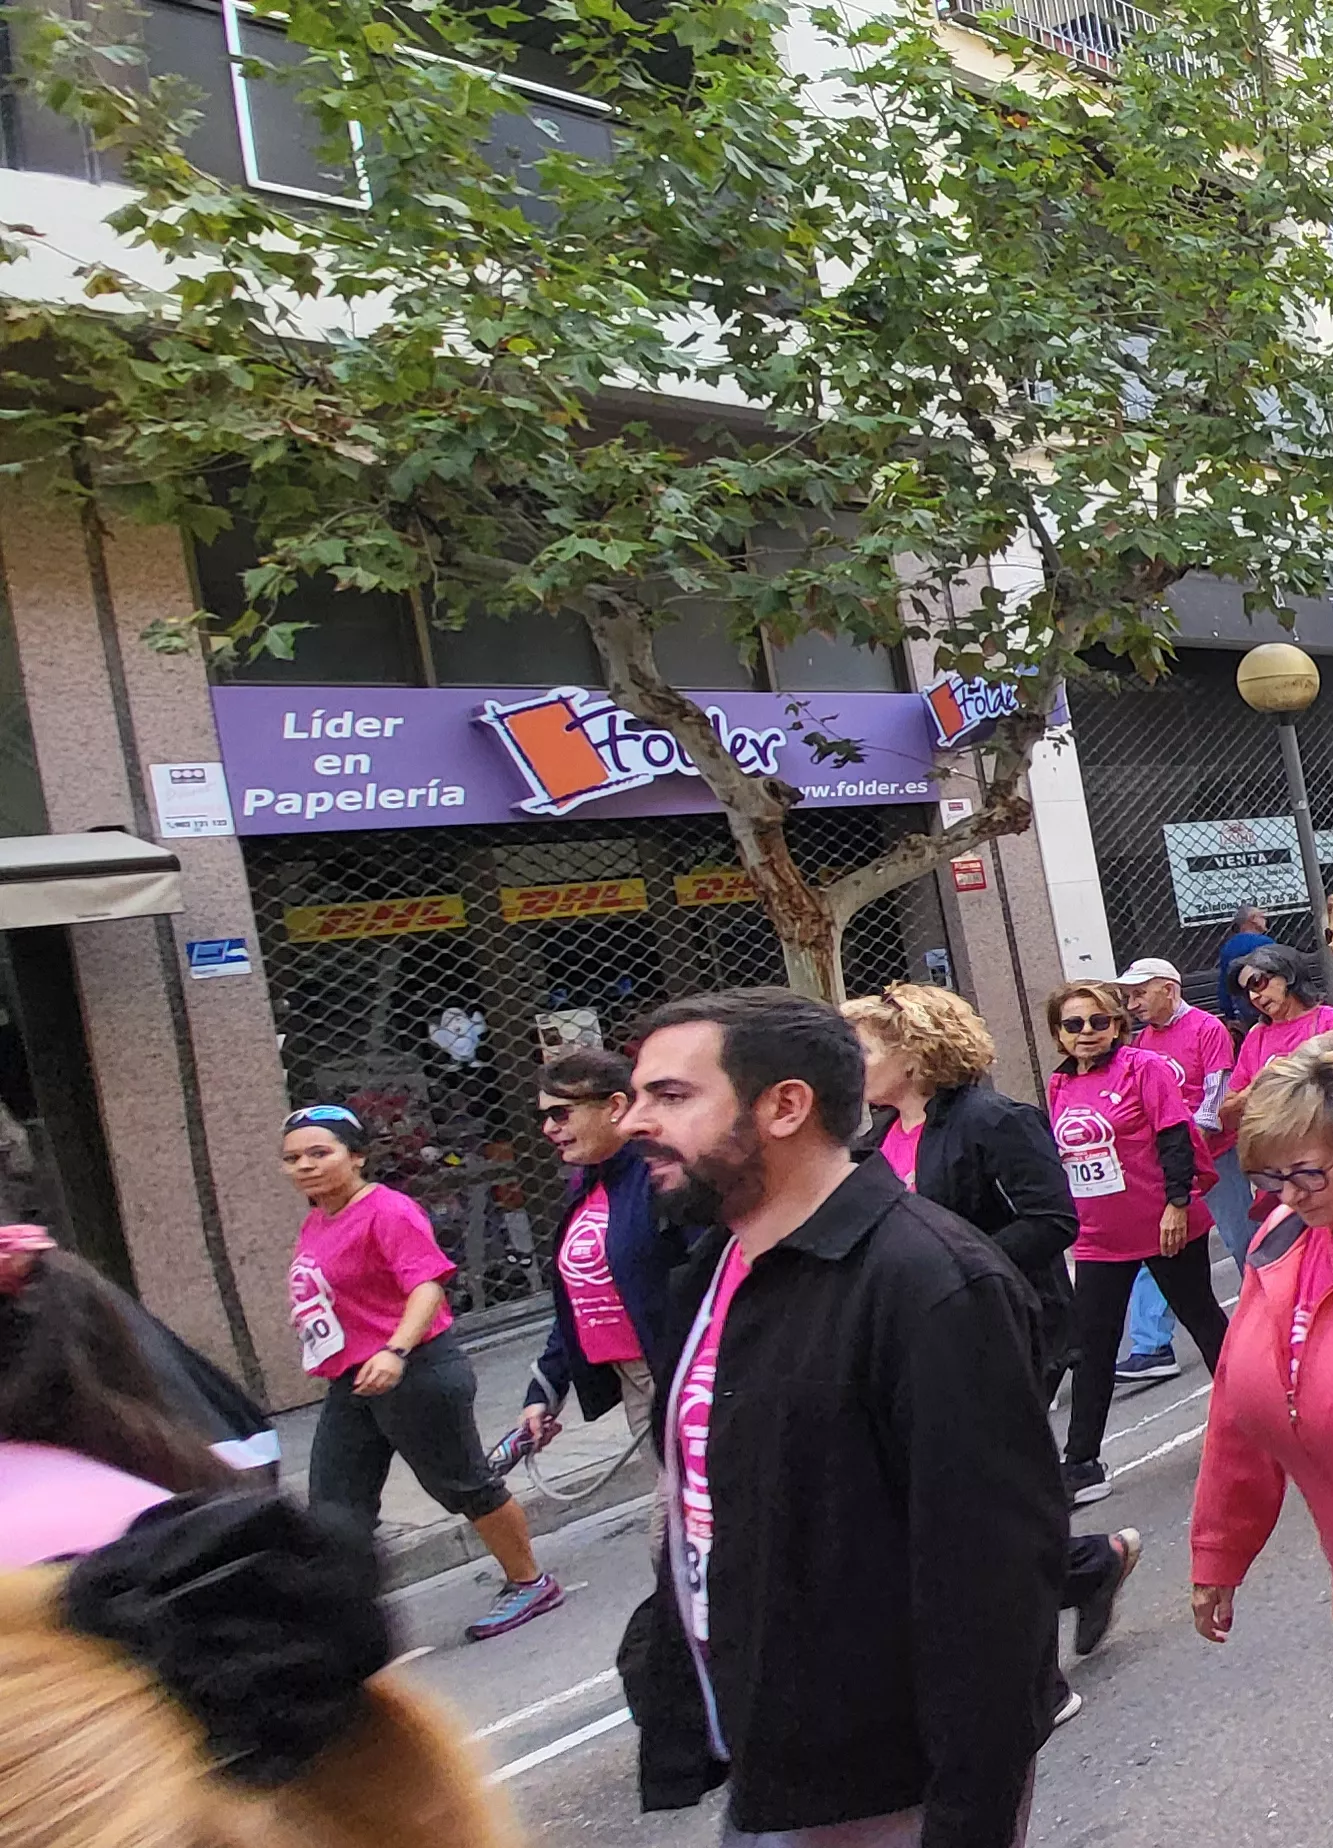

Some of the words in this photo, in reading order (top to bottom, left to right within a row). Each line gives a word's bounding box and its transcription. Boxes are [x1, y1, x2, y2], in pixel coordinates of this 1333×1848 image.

[283, 708, 405, 739] Líder
[313, 752, 372, 776] en
[243, 778, 466, 820] Papelería
[1213, 852, 1269, 869] VENTA
[516, 882, 632, 915] DHL
[316, 900, 453, 936] DHL
